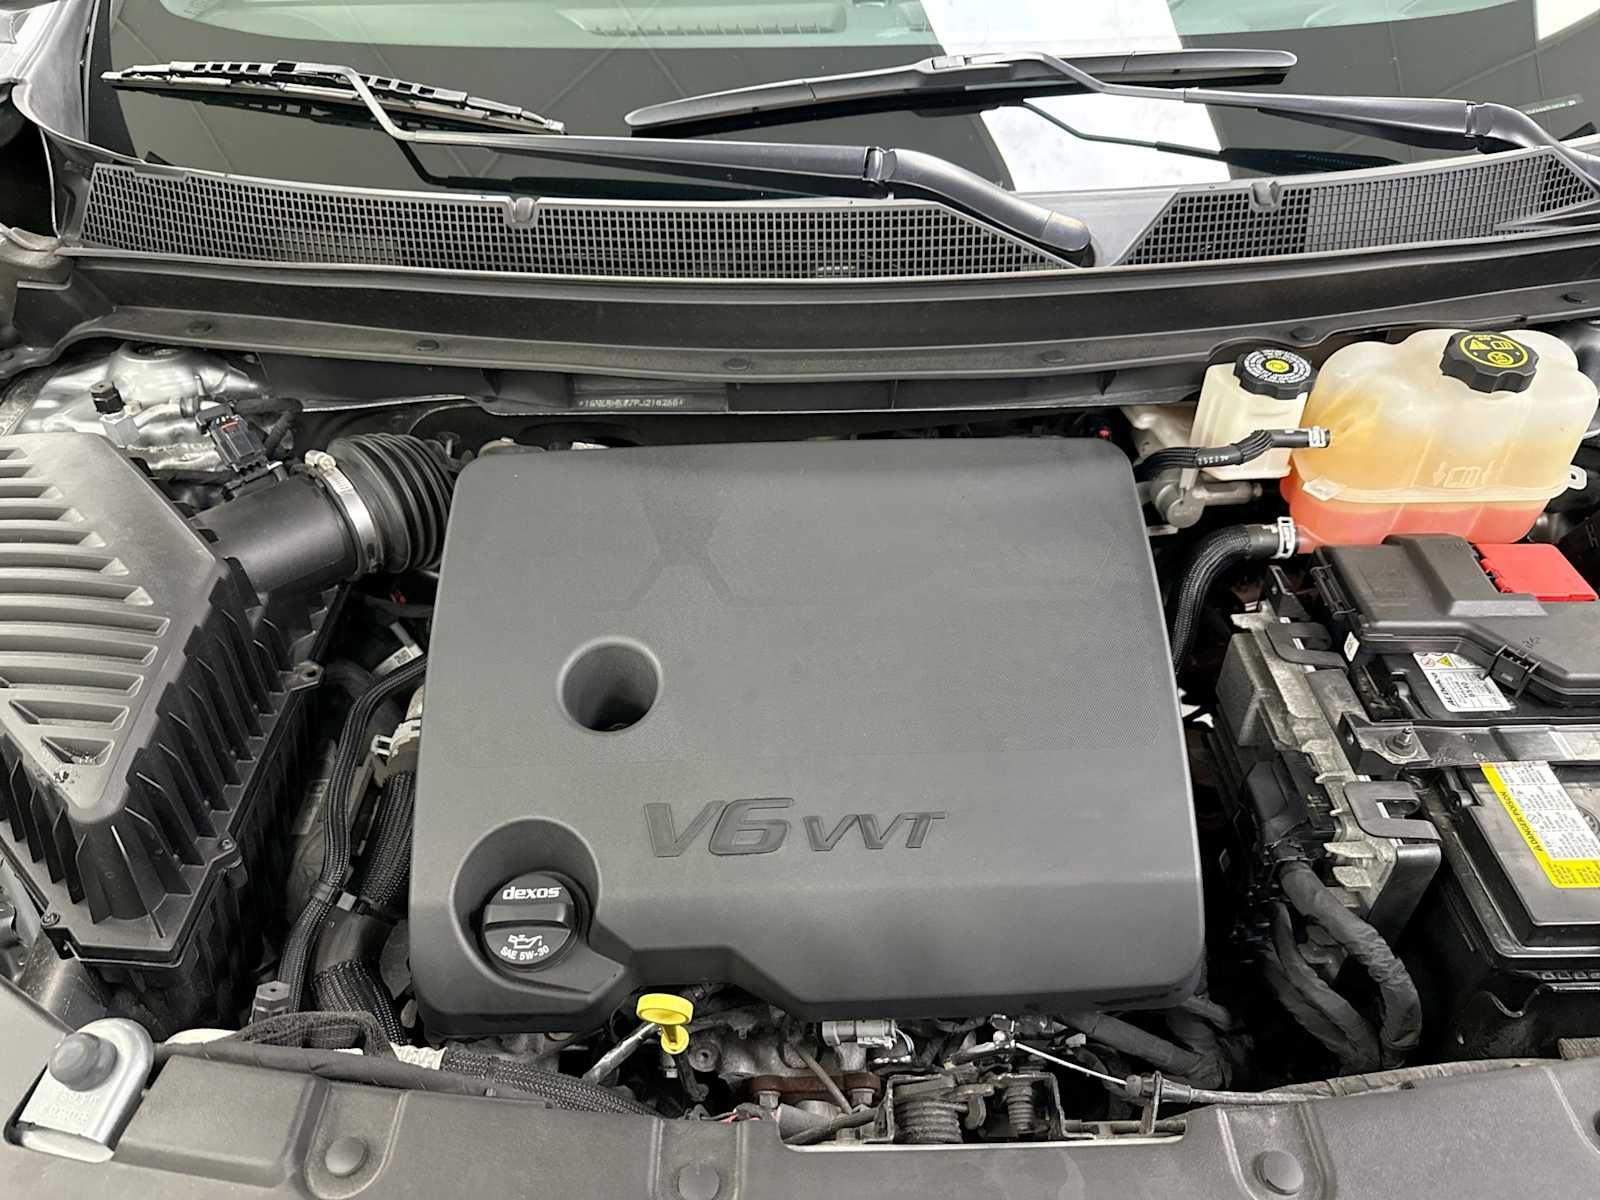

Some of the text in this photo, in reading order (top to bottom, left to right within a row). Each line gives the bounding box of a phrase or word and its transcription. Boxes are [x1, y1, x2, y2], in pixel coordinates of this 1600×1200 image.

[643, 797, 947, 858] V6 VVT
[1500, 791, 1538, 845] DANGER POISON
[502, 886, 562, 900] dexos
[500, 945, 550, 960] SAE 5W-30
